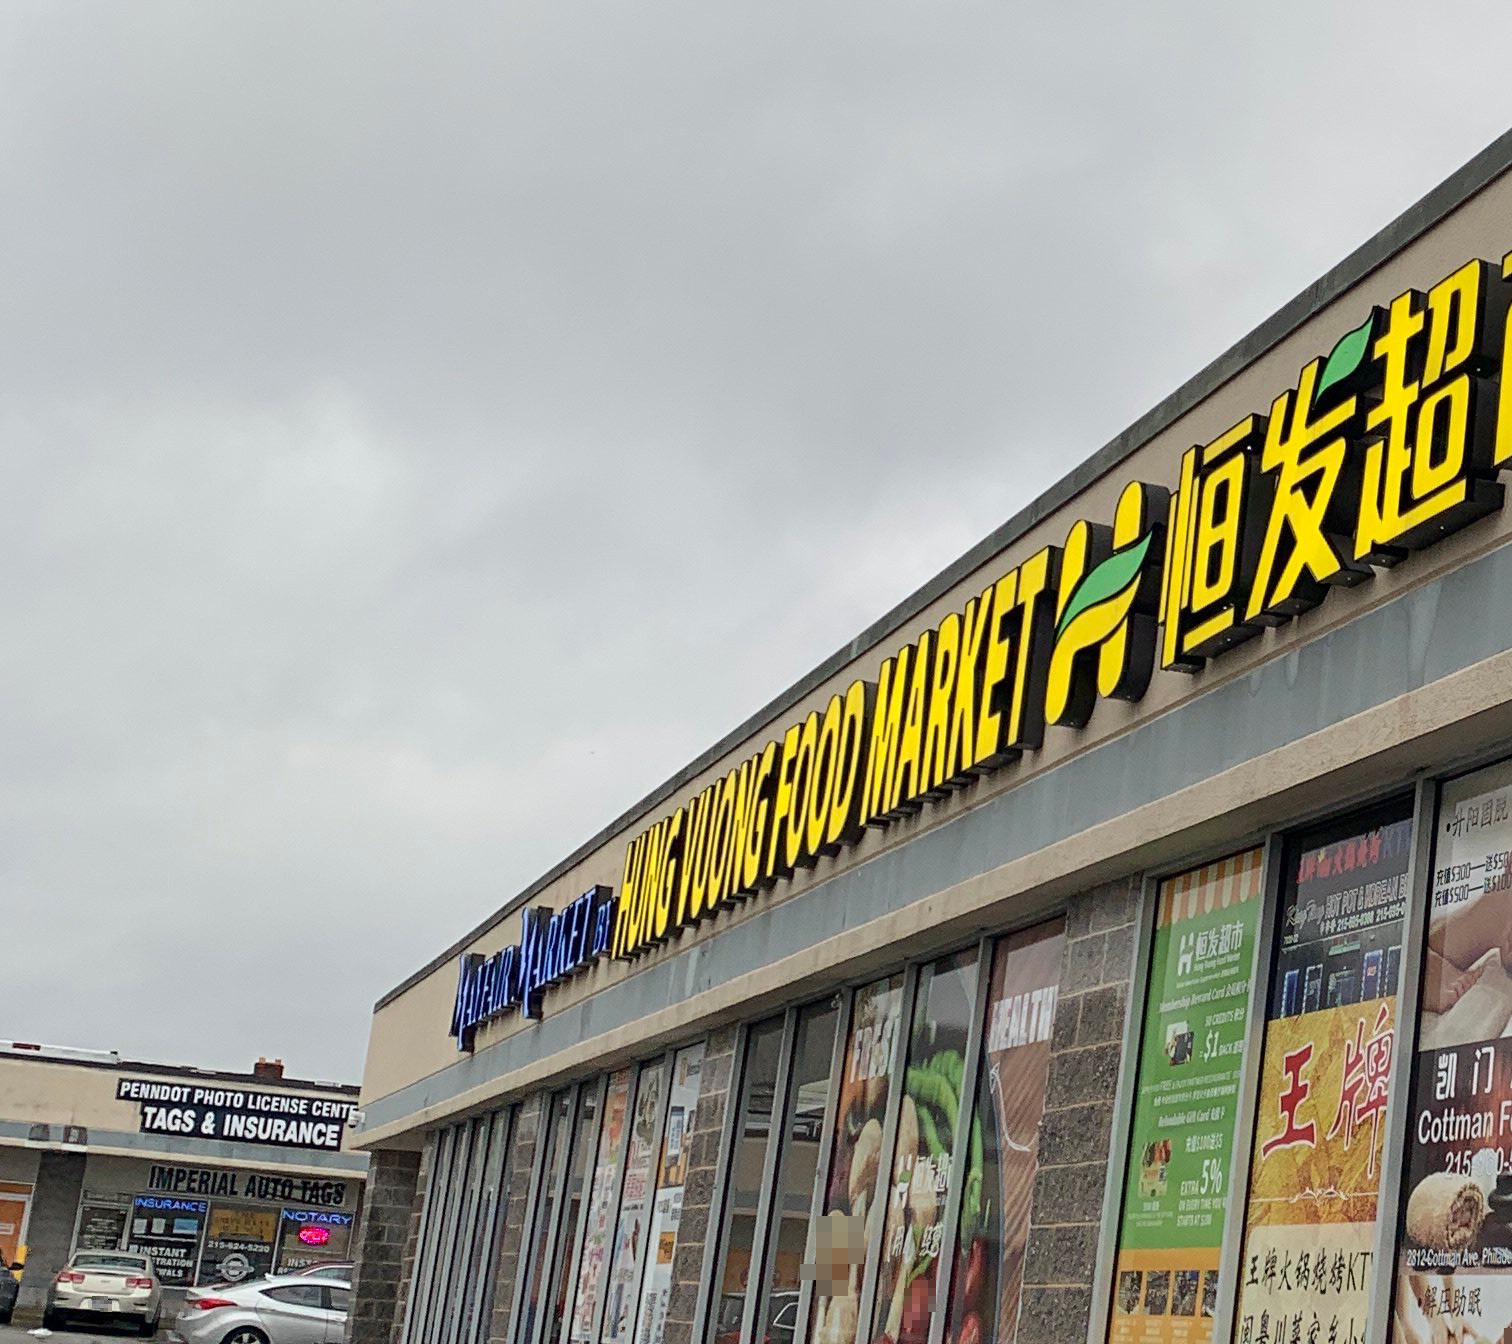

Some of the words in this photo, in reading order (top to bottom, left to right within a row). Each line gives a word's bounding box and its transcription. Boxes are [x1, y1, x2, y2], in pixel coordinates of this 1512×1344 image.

[612, 807, 683, 959] HUNG
[676, 741, 777, 926] VUONG
[766, 680, 866, 876] FOOD
[861, 545, 1051, 825] MARKET
[1195, 920, 1244, 961] 恒发超市
[119, 1081, 188, 1104] PENNDOT
[193, 1088, 243, 1109] PHOTO
[247, 1094, 308, 1115] LICENSE
[1262, 1002, 1394, 1179] 王牌
[143, 1106, 196, 1133] TAGS
[200, 1111, 216, 1135] &
[222, 1113, 341, 1147] INSURANCE
[1418, 1107, 1494, 1144] Cottman
[149, 1165, 239, 1197] IMPERIAL
[244, 1174, 293, 1201] AUTO
[299, 1180, 347, 1206] TAGS
[1200, 1157, 1222, 1194] 5%
[134, 1197, 207, 1213] INSURANCE
[282, 1210, 352, 1225] NOTARY
[138, 1245, 187, 1258] INSTANT
[1245, 1247, 1374, 1296] 王牌火锅烧烤KT
